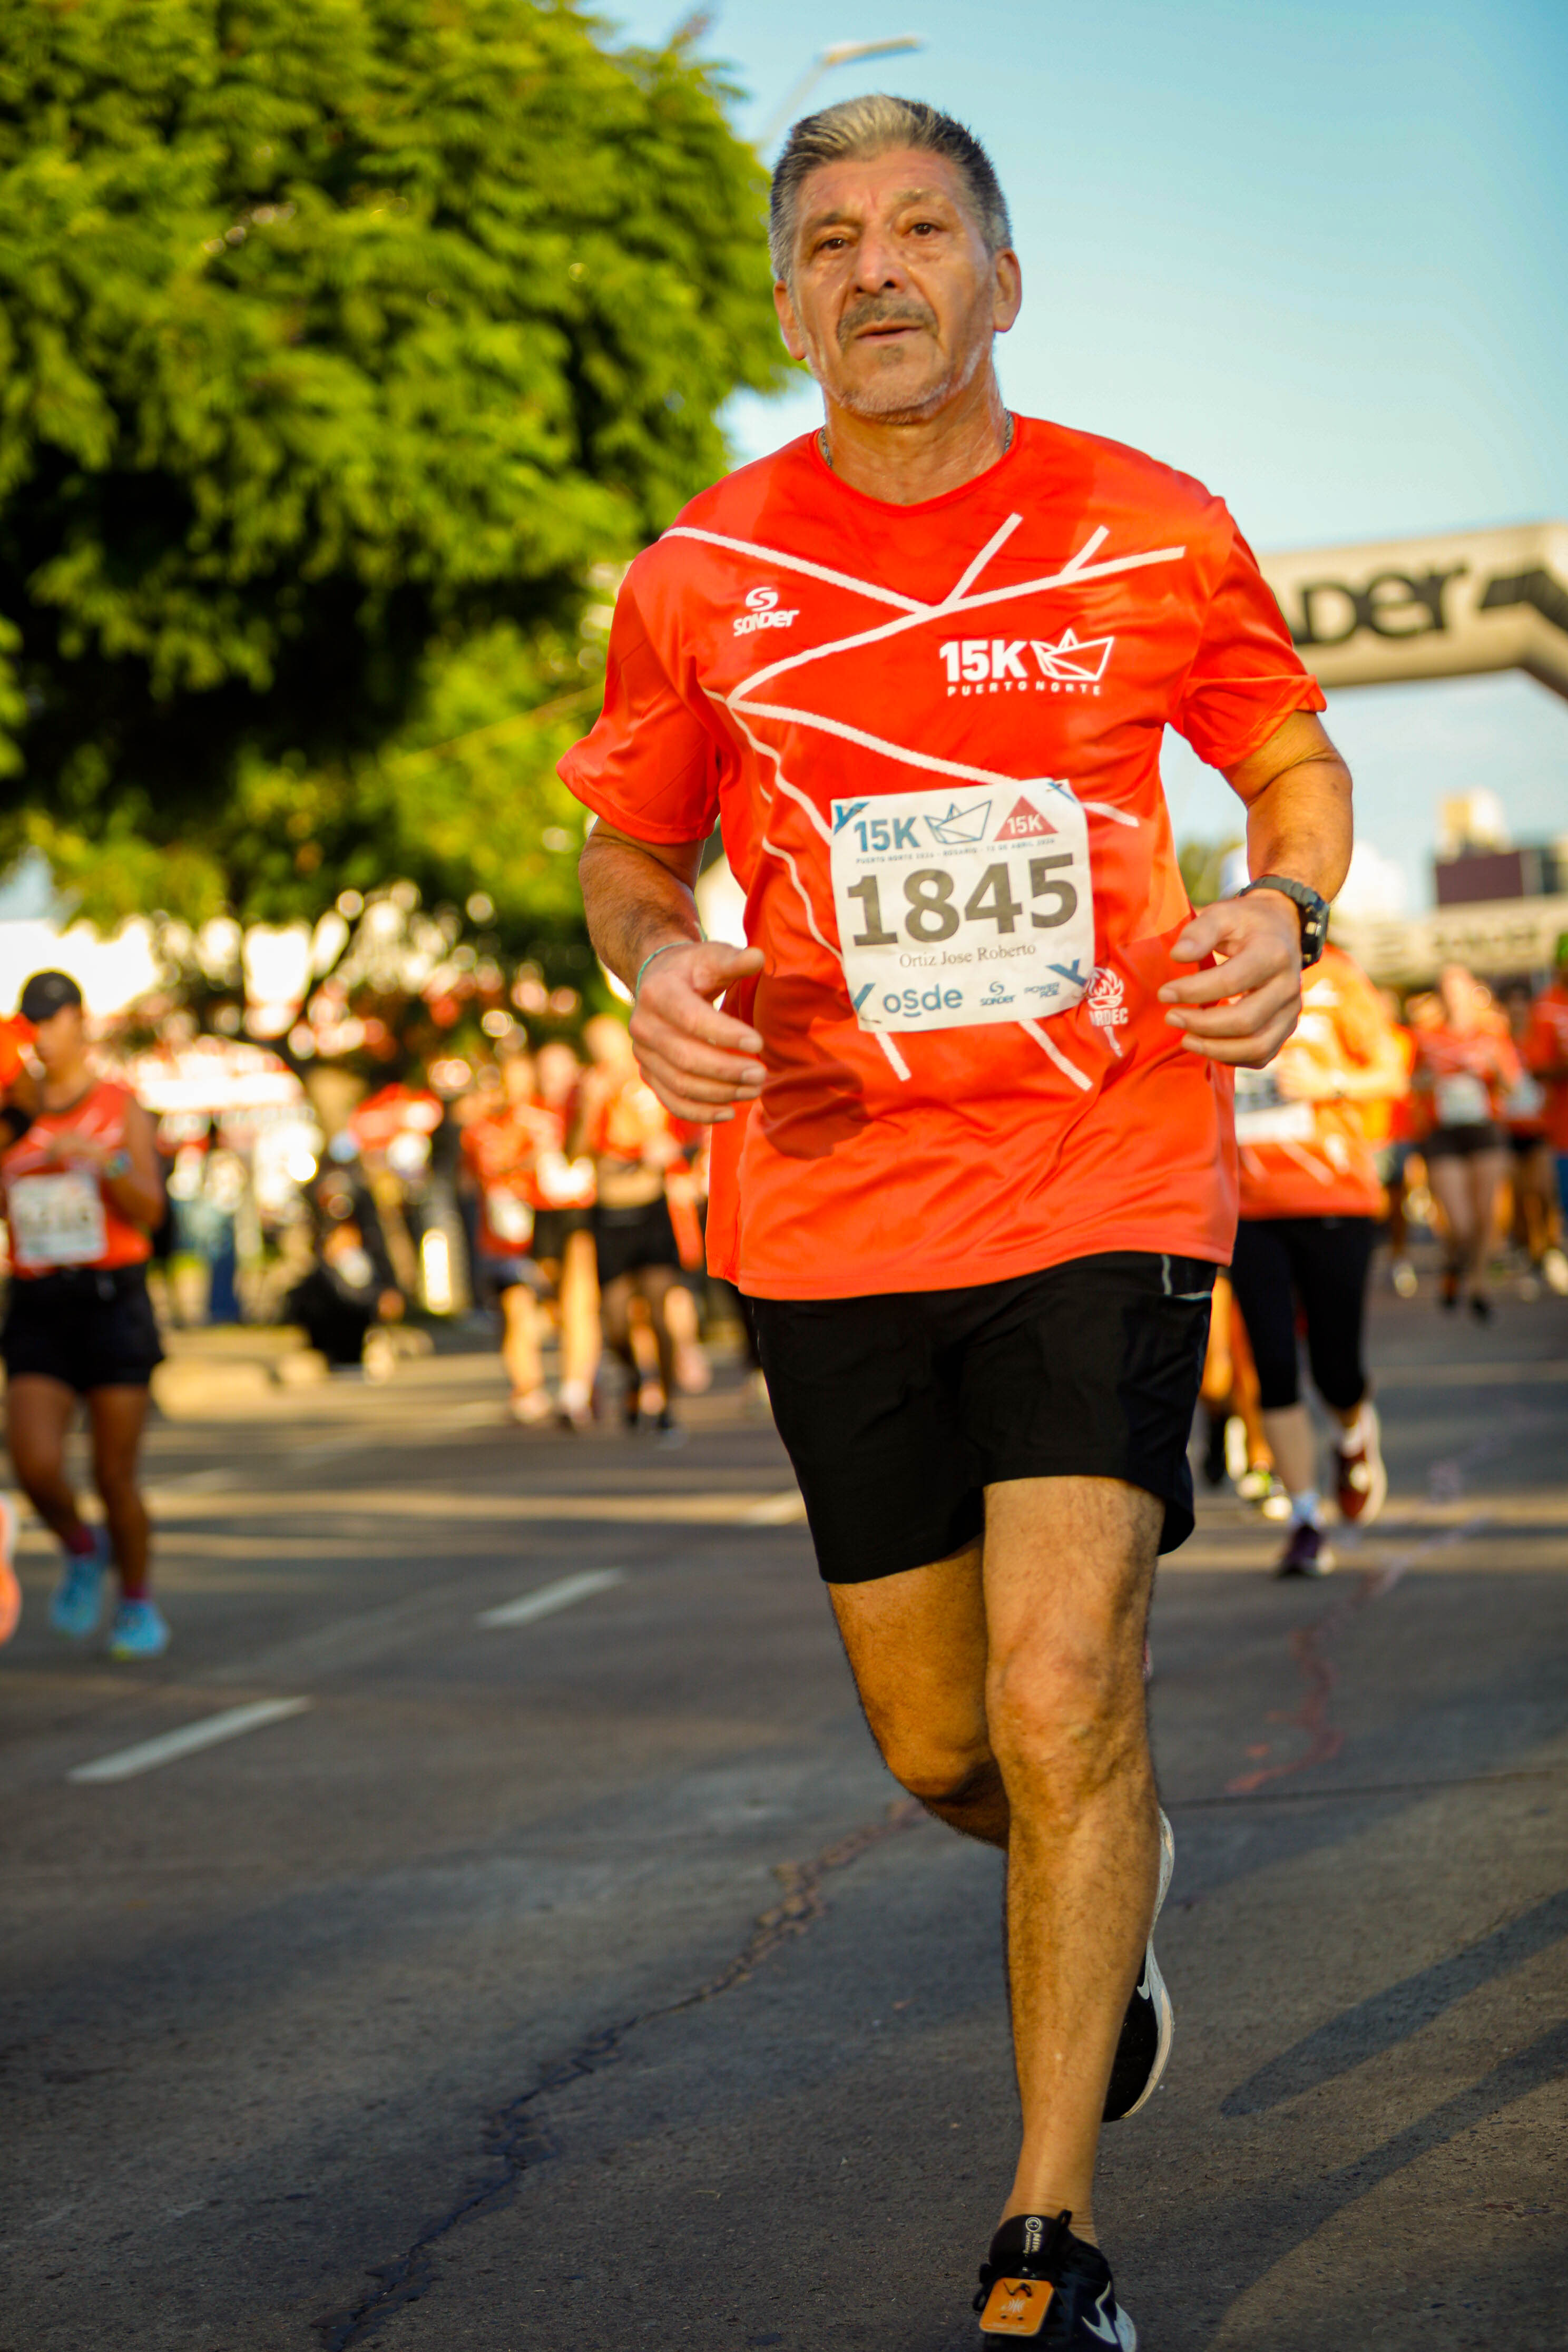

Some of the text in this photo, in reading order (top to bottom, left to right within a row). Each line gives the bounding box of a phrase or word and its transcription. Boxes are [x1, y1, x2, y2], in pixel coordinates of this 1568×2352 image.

[939, 639, 1027, 682] 15K
[947, 680, 1101, 697] PUERTO NORTE
[854, 817, 921, 852] 15K
[1006, 814, 1043, 835] 15K
[847, 853, 1078, 946] 1845
[899, 944, 1036, 968] Ortiz Jose Roberto
[883, 983, 963, 1016] osde
